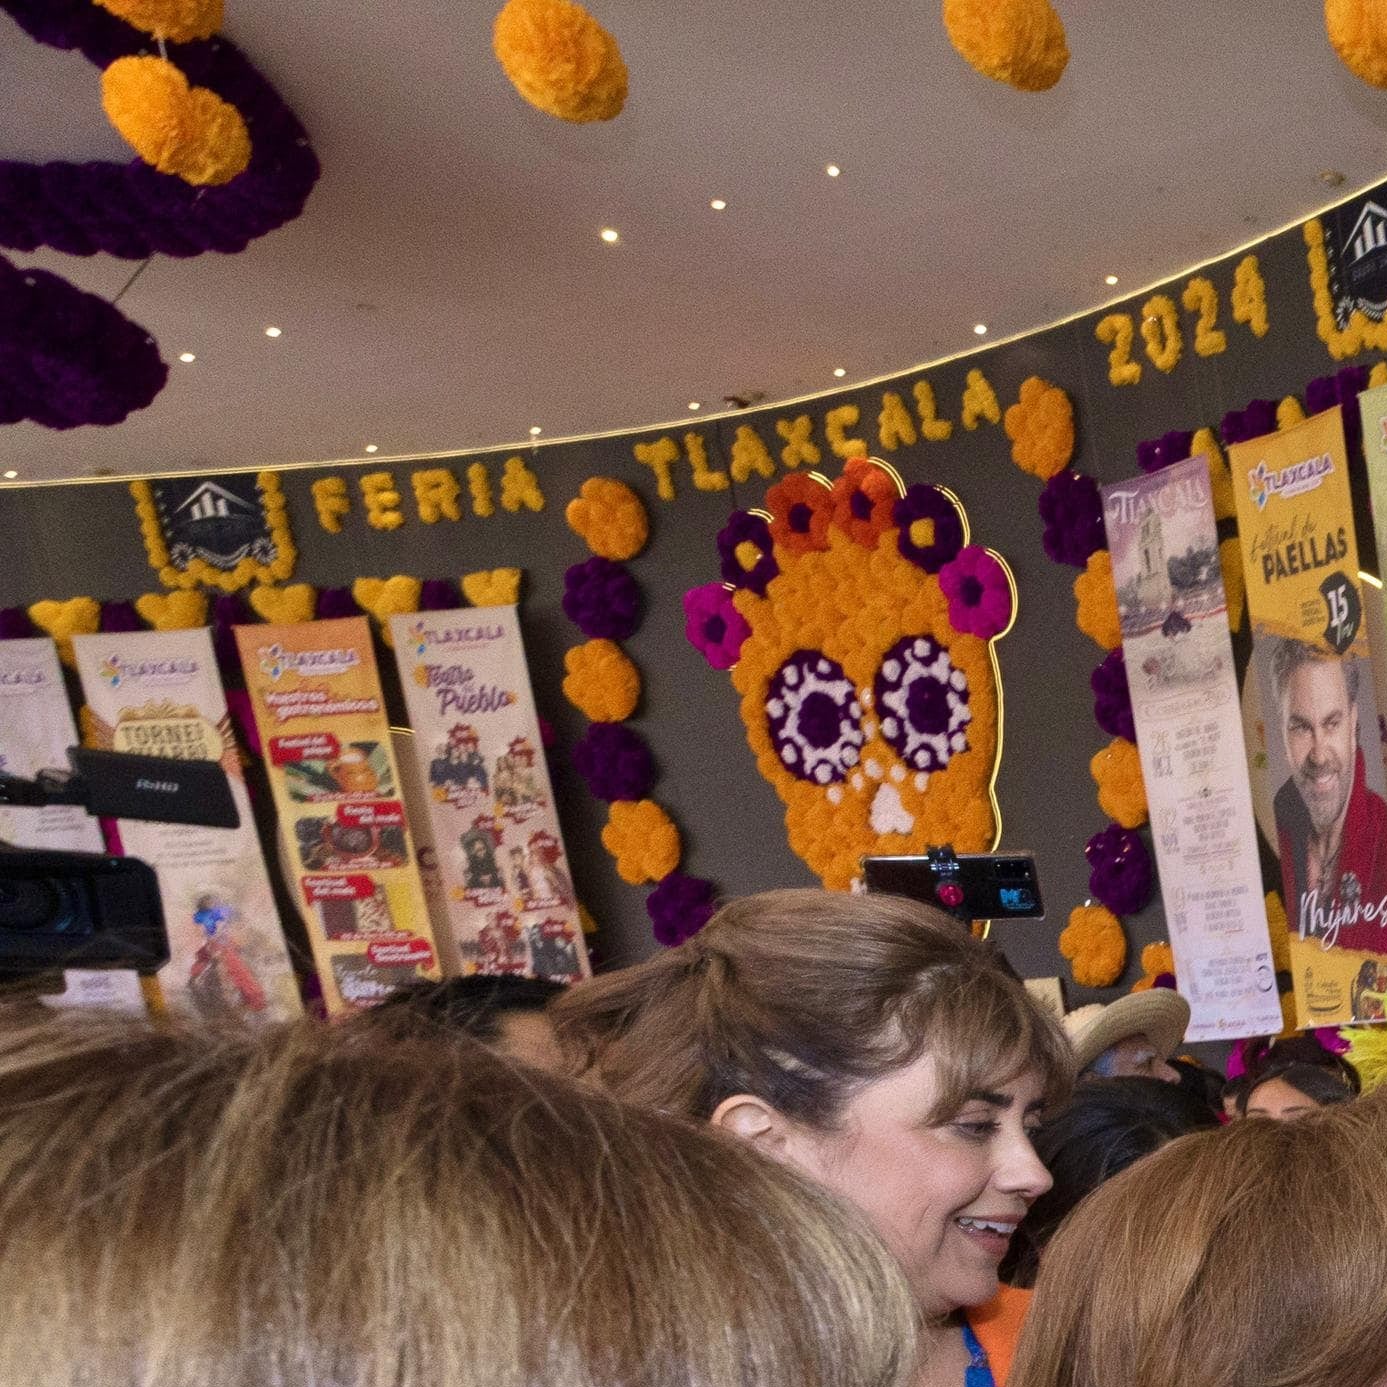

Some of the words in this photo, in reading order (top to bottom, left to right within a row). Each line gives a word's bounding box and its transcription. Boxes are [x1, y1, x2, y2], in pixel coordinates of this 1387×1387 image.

[312, 456, 545, 533] FERIA
[634, 368, 1001, 501] TLAXCALA
[1095, 255, 1270, 388] 2024
[1264, 455, 1333, 493] TLAXCALA
[1262, 527, 1348, 584] PAELLAS
[436, 684, 513, 716] Pueblo
